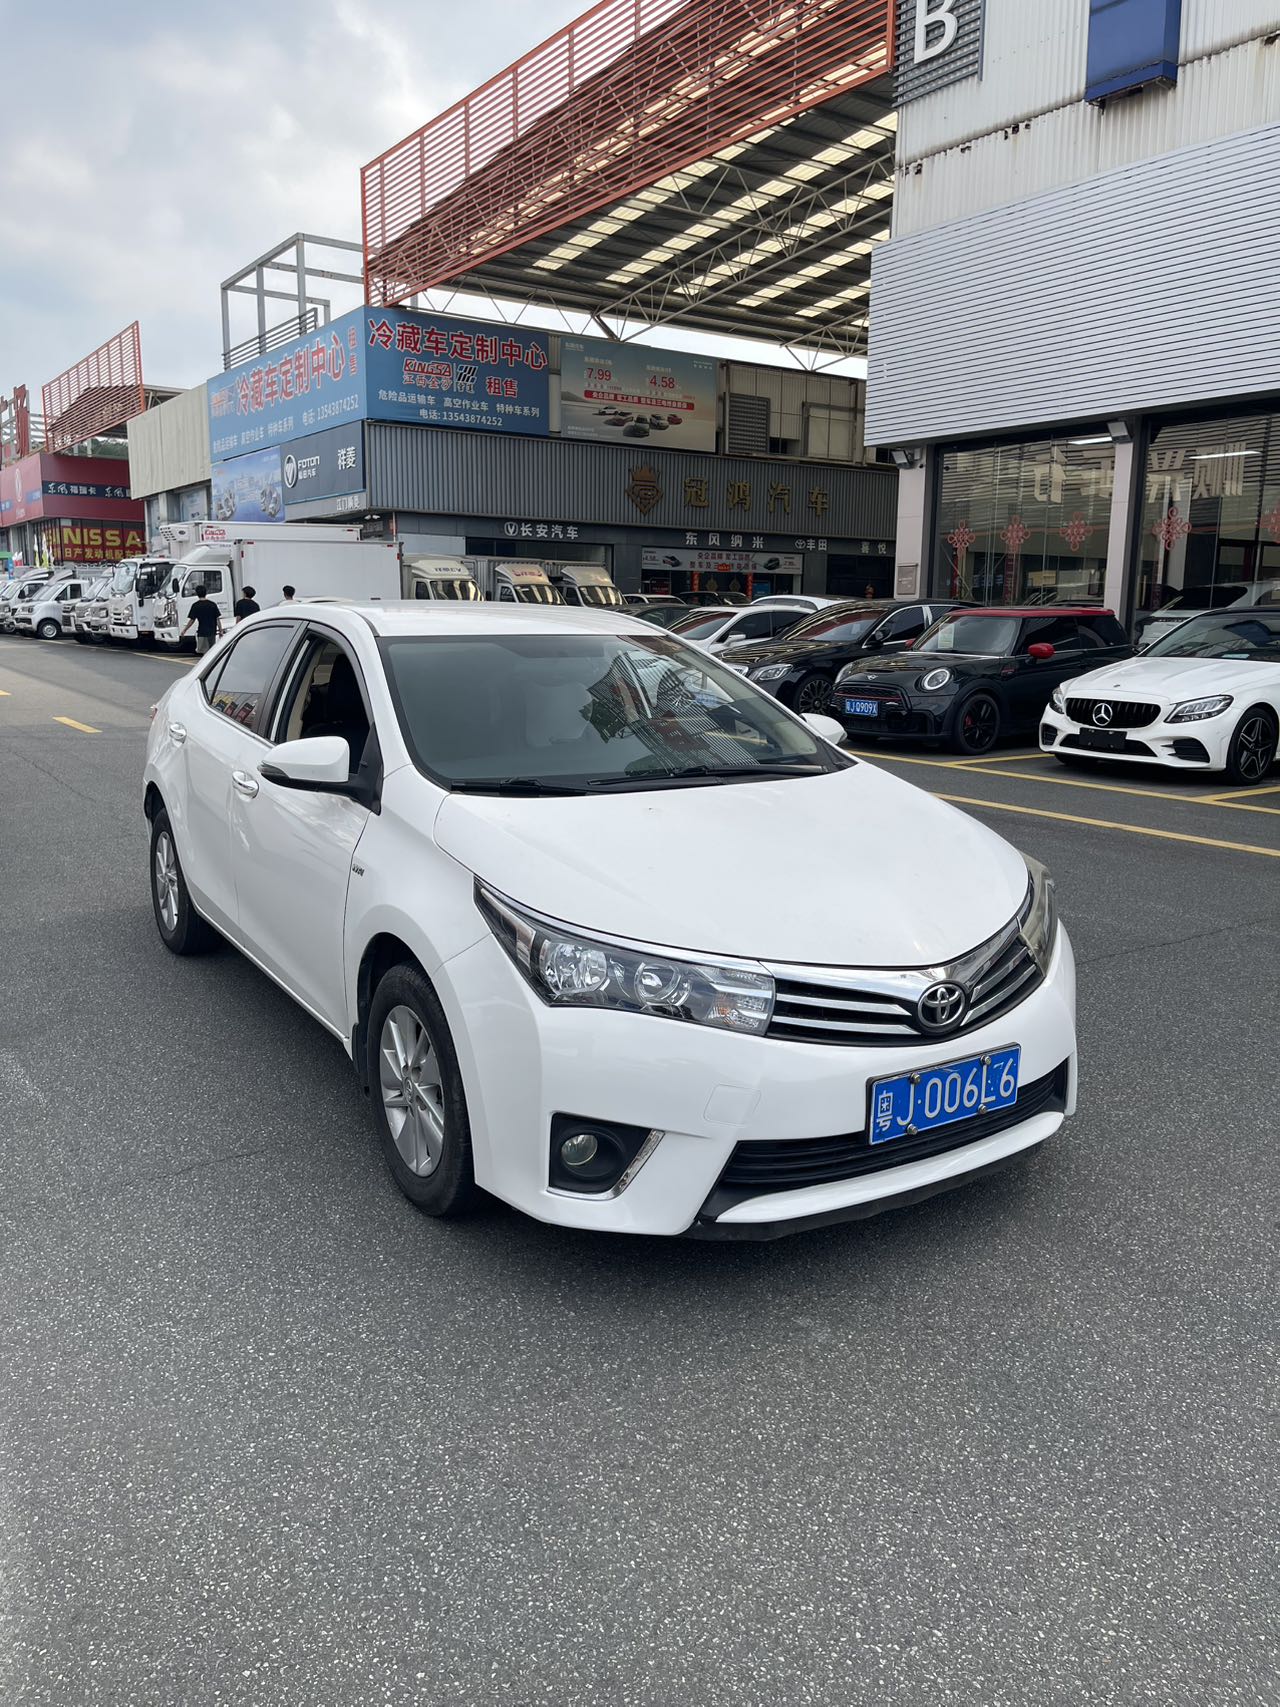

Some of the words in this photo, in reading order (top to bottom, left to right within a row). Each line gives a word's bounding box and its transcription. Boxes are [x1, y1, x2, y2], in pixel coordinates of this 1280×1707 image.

[914, 0, 957, 64] B
[368, 318, 548, 371] 冷藏车定制中心
[236, 331, 346, 416] 冷藏车定制中心
[587, 367, 612, 381] 7.99
[650, 375, 675, 389] 4.58
[486, 376, 519, 398] 租售
[378, 389, 437, 406] 危险品运输车
[443, 397, 489, 411] 高空作业车
[496, 403, 540, 418] 特种车系列
[298, 456, 320, 469] FOTON
[337, 446, 356, 470] 祥菱
[684, 477, 829, 516] 冠鸿汽车
[520, 522, 579, 539] 长安汽车
[685, 531, 764, 549] 东风纳米
[806, 539, 827, 551] 丰田
